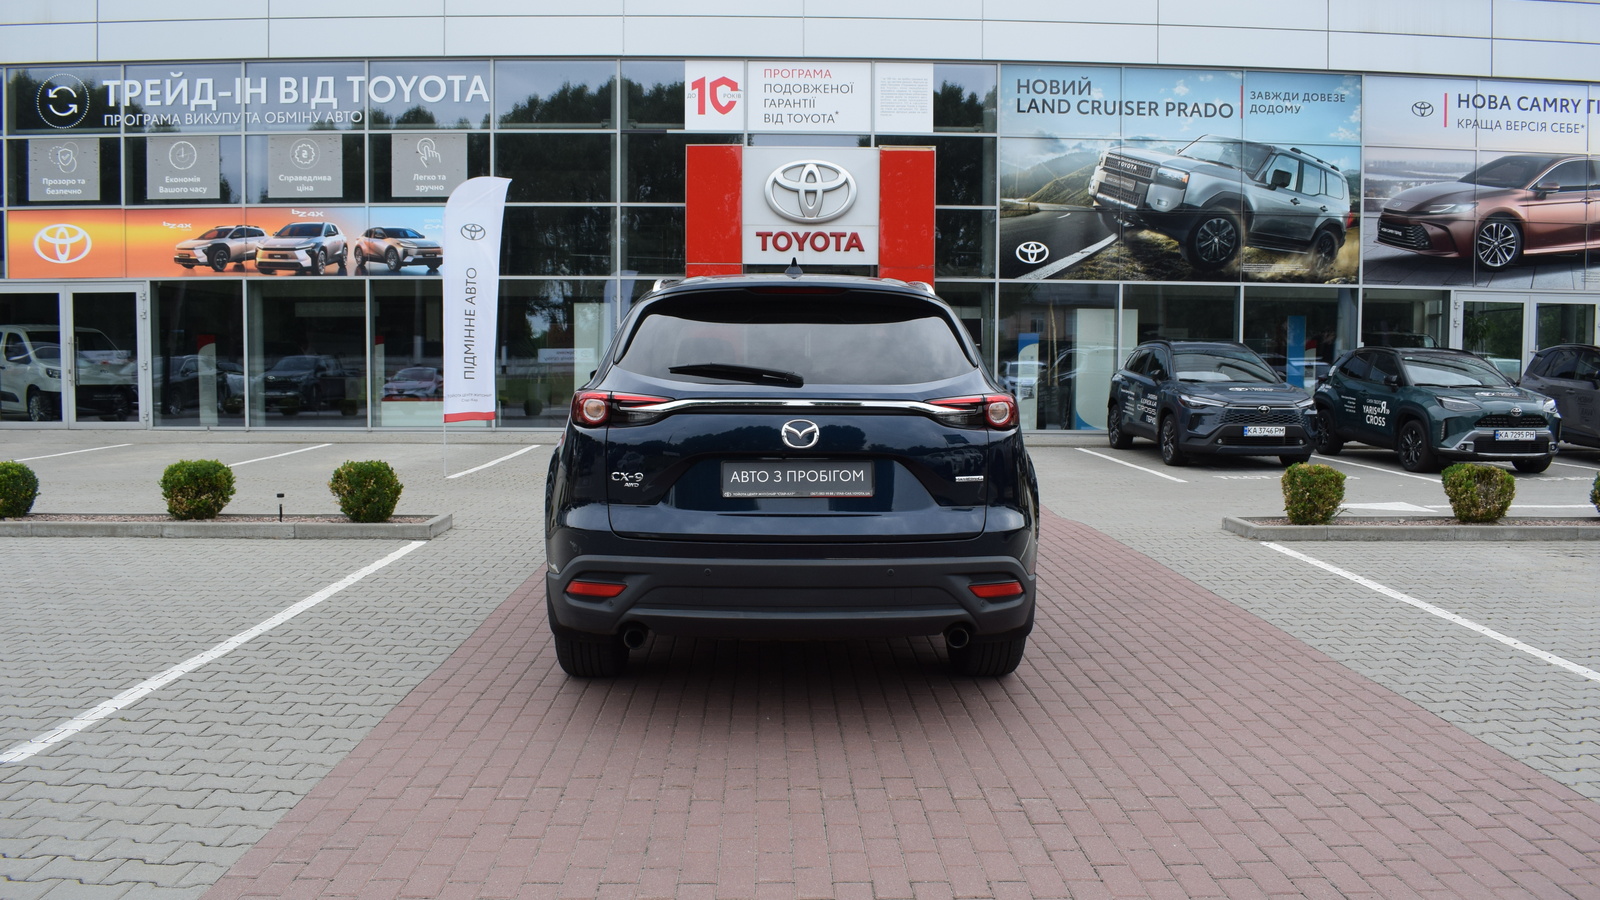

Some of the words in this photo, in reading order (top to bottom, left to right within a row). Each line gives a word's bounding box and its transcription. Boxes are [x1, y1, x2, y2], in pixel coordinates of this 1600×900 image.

[763, 68, 832, 79] ПРОГРАМА
[102, 71, 267, 111] ТРЕЙД-ІН
[279, 76, 338, 110] ВІД
[346, 75, 490, 104] TOYOTA
[763, 82, 855, 95] ПОДОВЖЕНОЇ
[1016, 77, 1092, 96] НОВИЙ
[763, 96, 816, 109] ГАРАНТІЇ
[1249, 90, 1300, 103] ЗАВЖДИ
[1302, 92, 1346, 104] ДОВЕЗЕ
[1016, 99, 1072, 115] LAND
[1076, 99, 1160, 117] CRUISER
[1165, 102, 1234, 119] PRADO
[1457, 93, 1511, 111] НОВА
[1516, 96, 1582, 114] CAMRY
[1249, 104, 1302, 116] ДОДОМУ
[103, 113, 181, 127] ПРОГРАМА
[186, 112, 242, 125] ВИКУПУ
[245, 112, 261, 124] ТА
[264, 111, 322, 124] ОБМІНУ
[325, 110, 363, 123] АВТО
[763, 113, 784, 125] ВІД
[1457, 118, 1502, 132] КРАЩА
[1506, 121, 1547, 132] ВЕРСІЯ
[1117, 161, 1137, 171] TOYOTA
[42, 178, 76, 187] Прозоро
[165, 175, 201, 183] Економія
[278, 174, 332, 183] Справедлива
[413, 173, 436, 182] Легко
[46, 186, 82, 195] безпечно
[159, 186, 188, 194] Вашого
[189, 186, 207, 194] часу
[296, 183, 314, 193] ціна
[415, 184, 444, 192] зручно
[756, 231, 865, 253] TOYOTA
[464, 267, 477, 305] АВТО
[464, 309, 477, 380] ПІДМІННЕ
[1136, 403, 1157, 416] CROSS
[1362, 404, 1378, 415] YARIS
[1366, 414, 1386, 427] CROSS
[1258, 427, 1274, 435] 3746
[1510, 431, 1525, 439] 7295
[611, 471, 644, 482] CX-9
[730, 470, 769, 483] АВТО
[773, 470, 782, 483] З
[786, 469, 864, 482] ПРОБІГОМ
